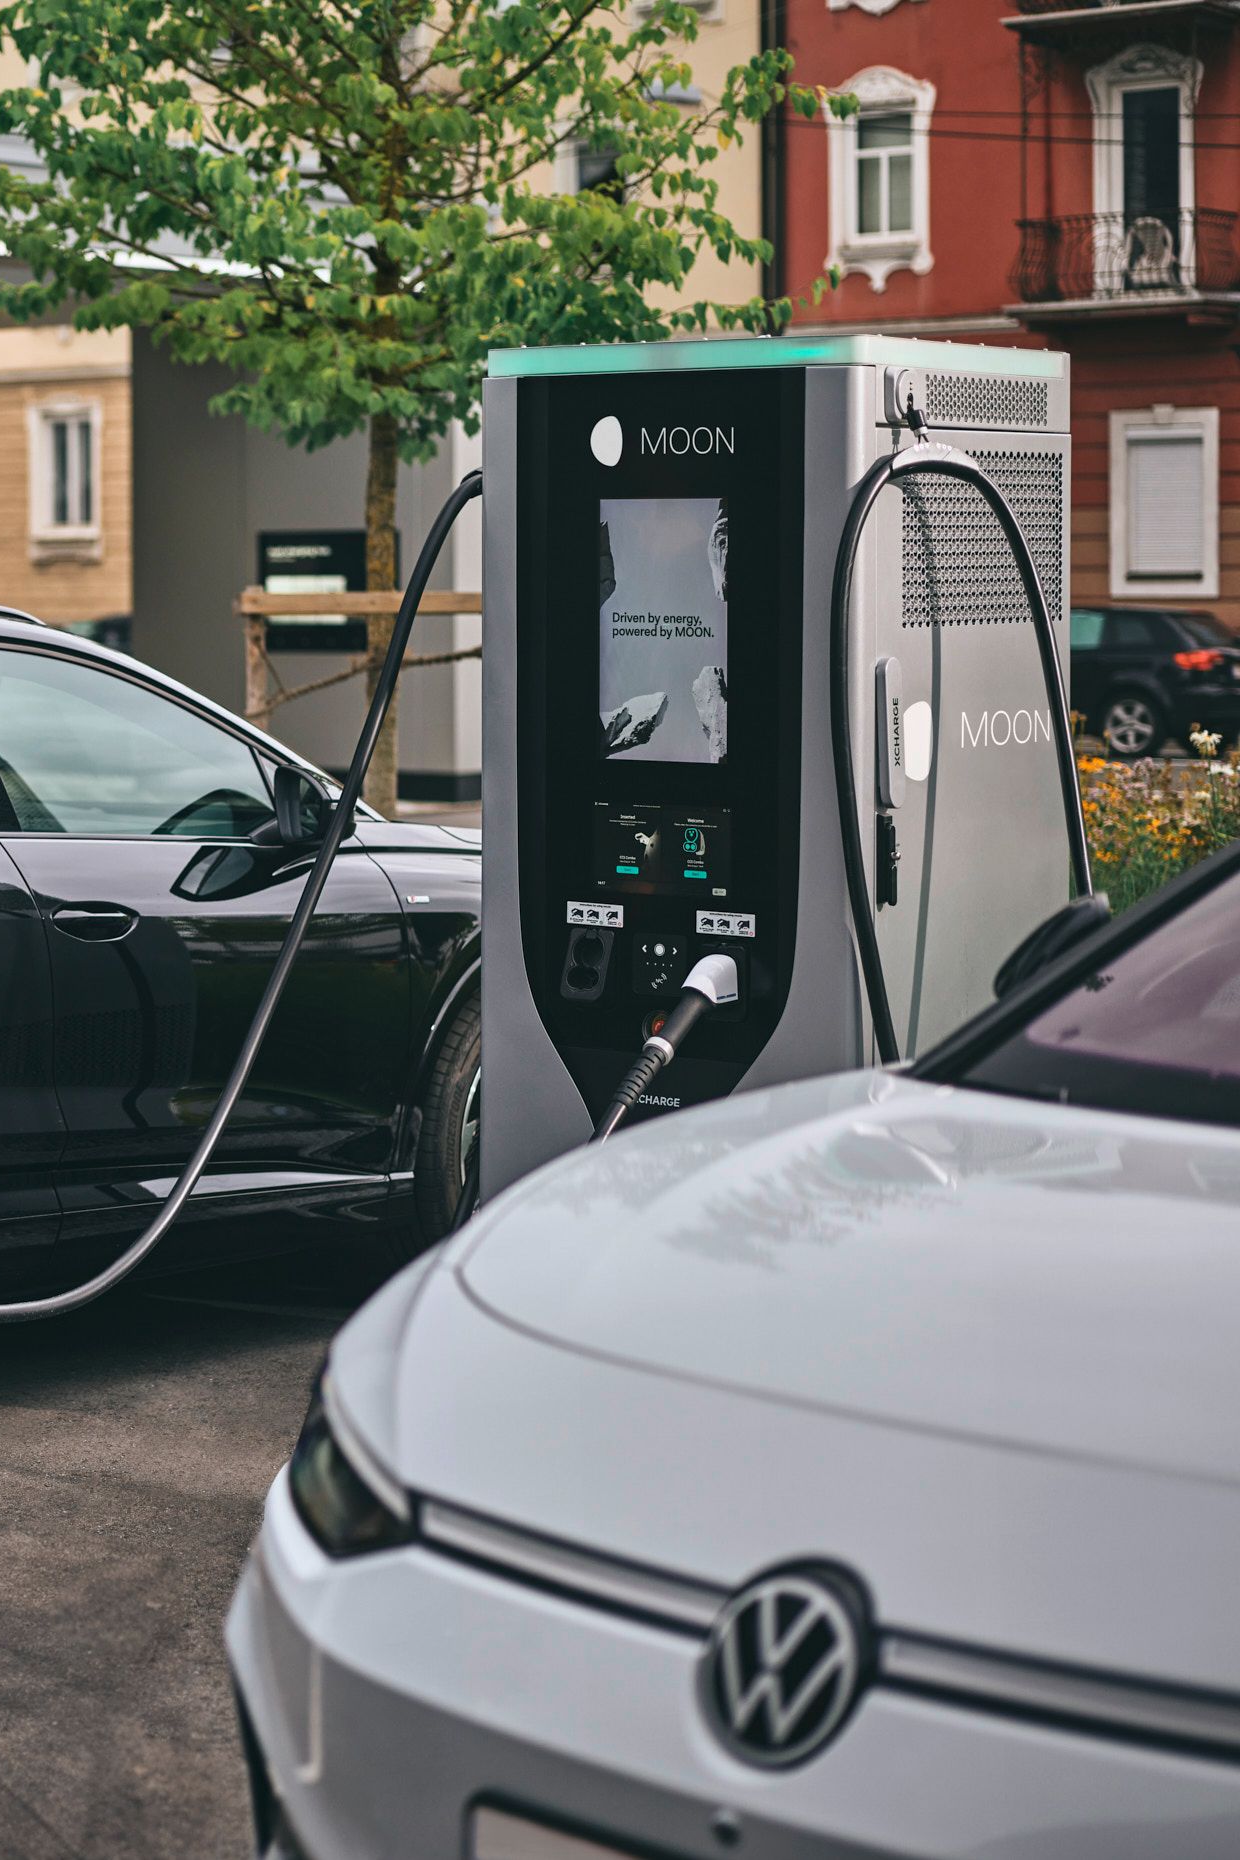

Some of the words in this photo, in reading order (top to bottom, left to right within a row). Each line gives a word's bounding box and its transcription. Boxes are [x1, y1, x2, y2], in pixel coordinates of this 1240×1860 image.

[641, 426, 735, 455] MOON
[612, 611, 646, 623] Driven
[648, 612, 661, 626] by
[663, 615, 703, 627] energy,
[612, 626, 658, 639] powered
[660, 626, 673, 640] by
[675, 626, 715, 638] MOON.
[891, 697, 901, 767] XCHARGE
[961, 709, 1051, 749] MOON
[636, 1094, 681, 1108] CHARGE
